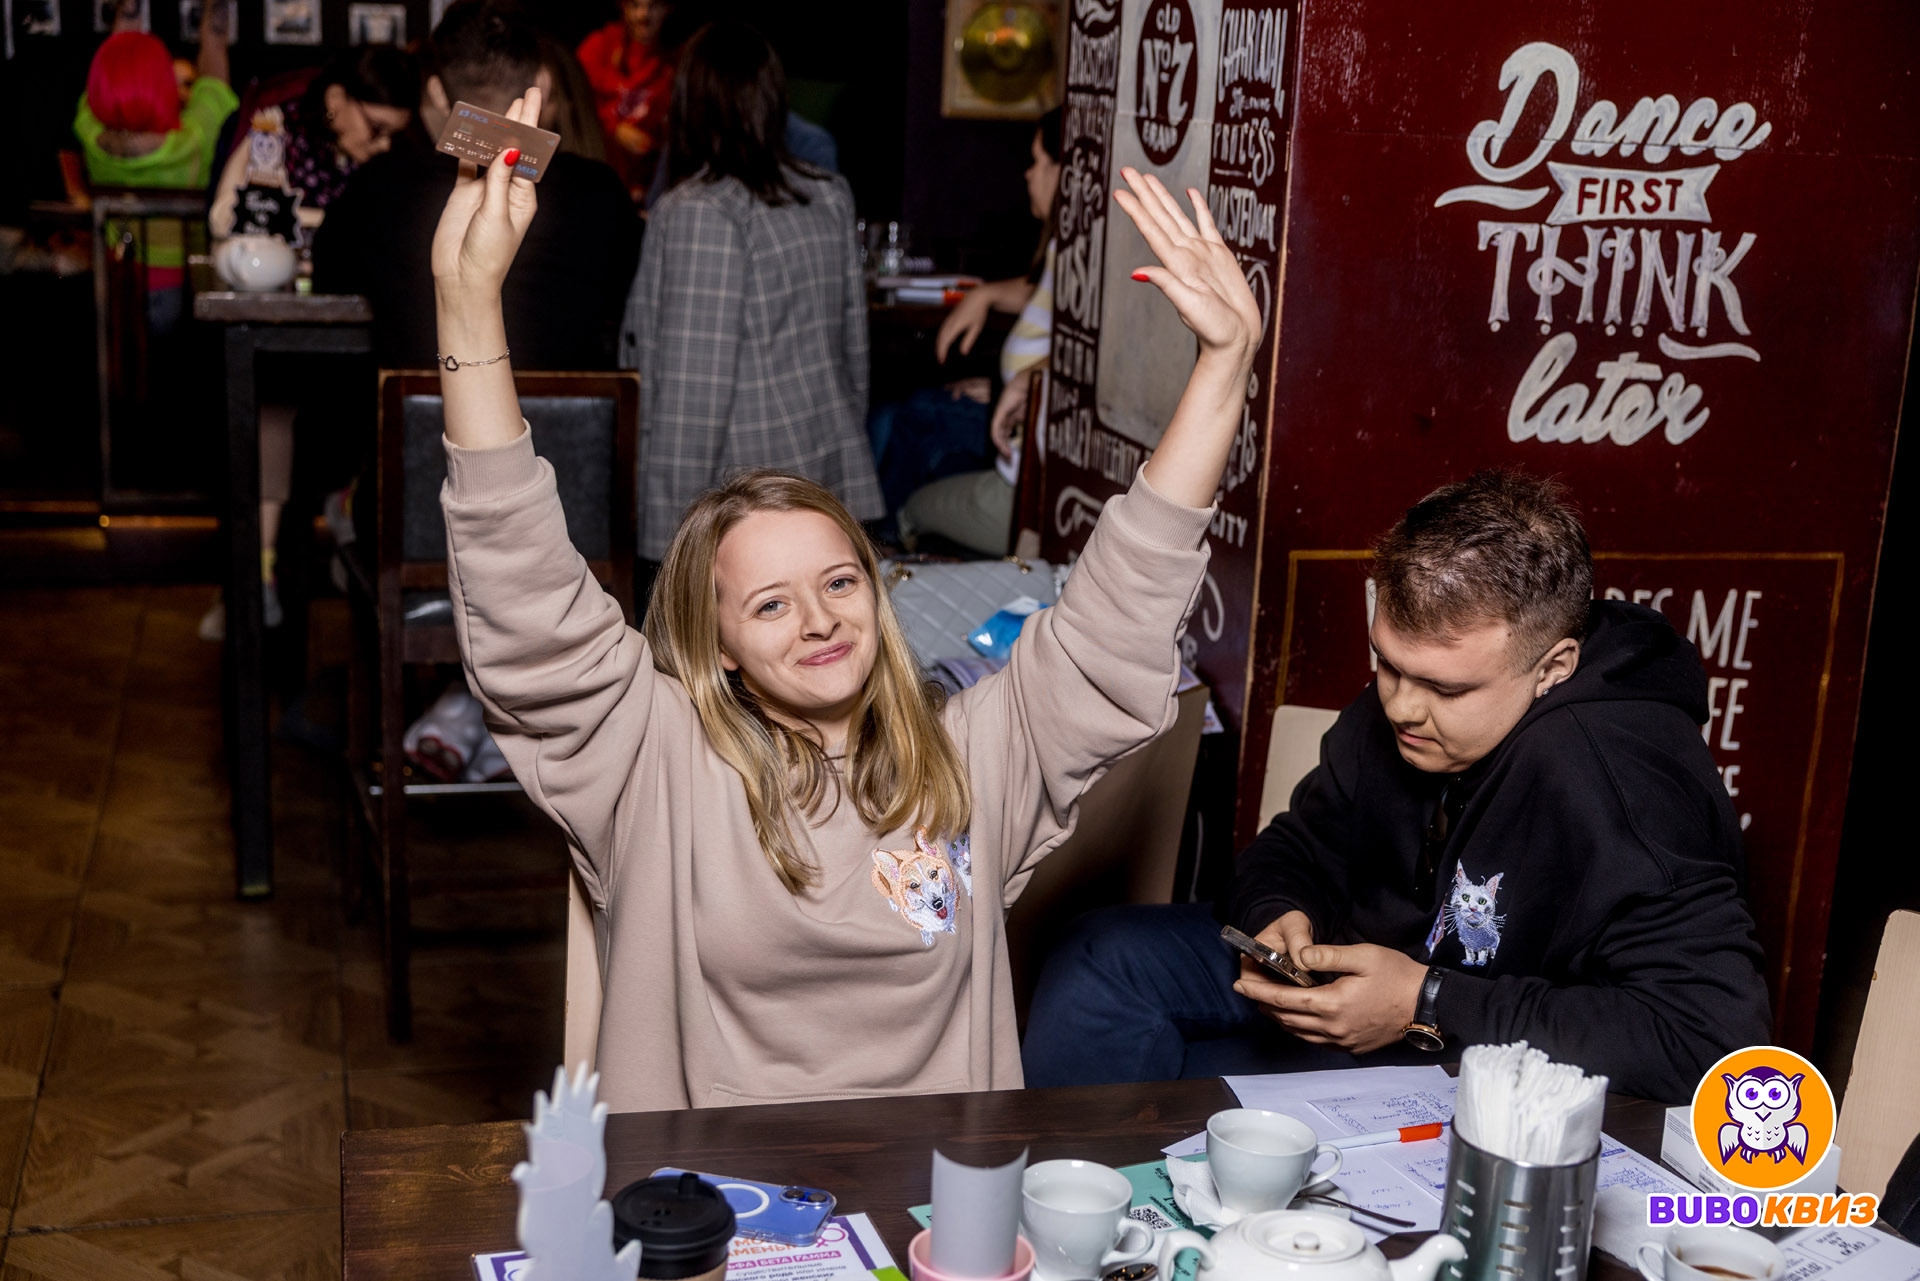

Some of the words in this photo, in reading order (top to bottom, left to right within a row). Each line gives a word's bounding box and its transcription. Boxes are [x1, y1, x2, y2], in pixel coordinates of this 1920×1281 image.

[1156, 3, 1181, 33] OLD
[1142, 121, 1178, 152] BRAND
[1466, 41, 1772, 182] Dance
[1213, 117, 1275, 187] PROCESS
[1577, 178, 1684, 215] FIRST
[1055, 216, 1104, 329] USA
[1478, 221, 1757, 337] THINK
[1507, 331, 1710, 446] later
[1686, 588, 1762, 670] ME
[760, 1257, 792, 1267] БЕТА
[795, 1252, 840, 1262] ГАММА
